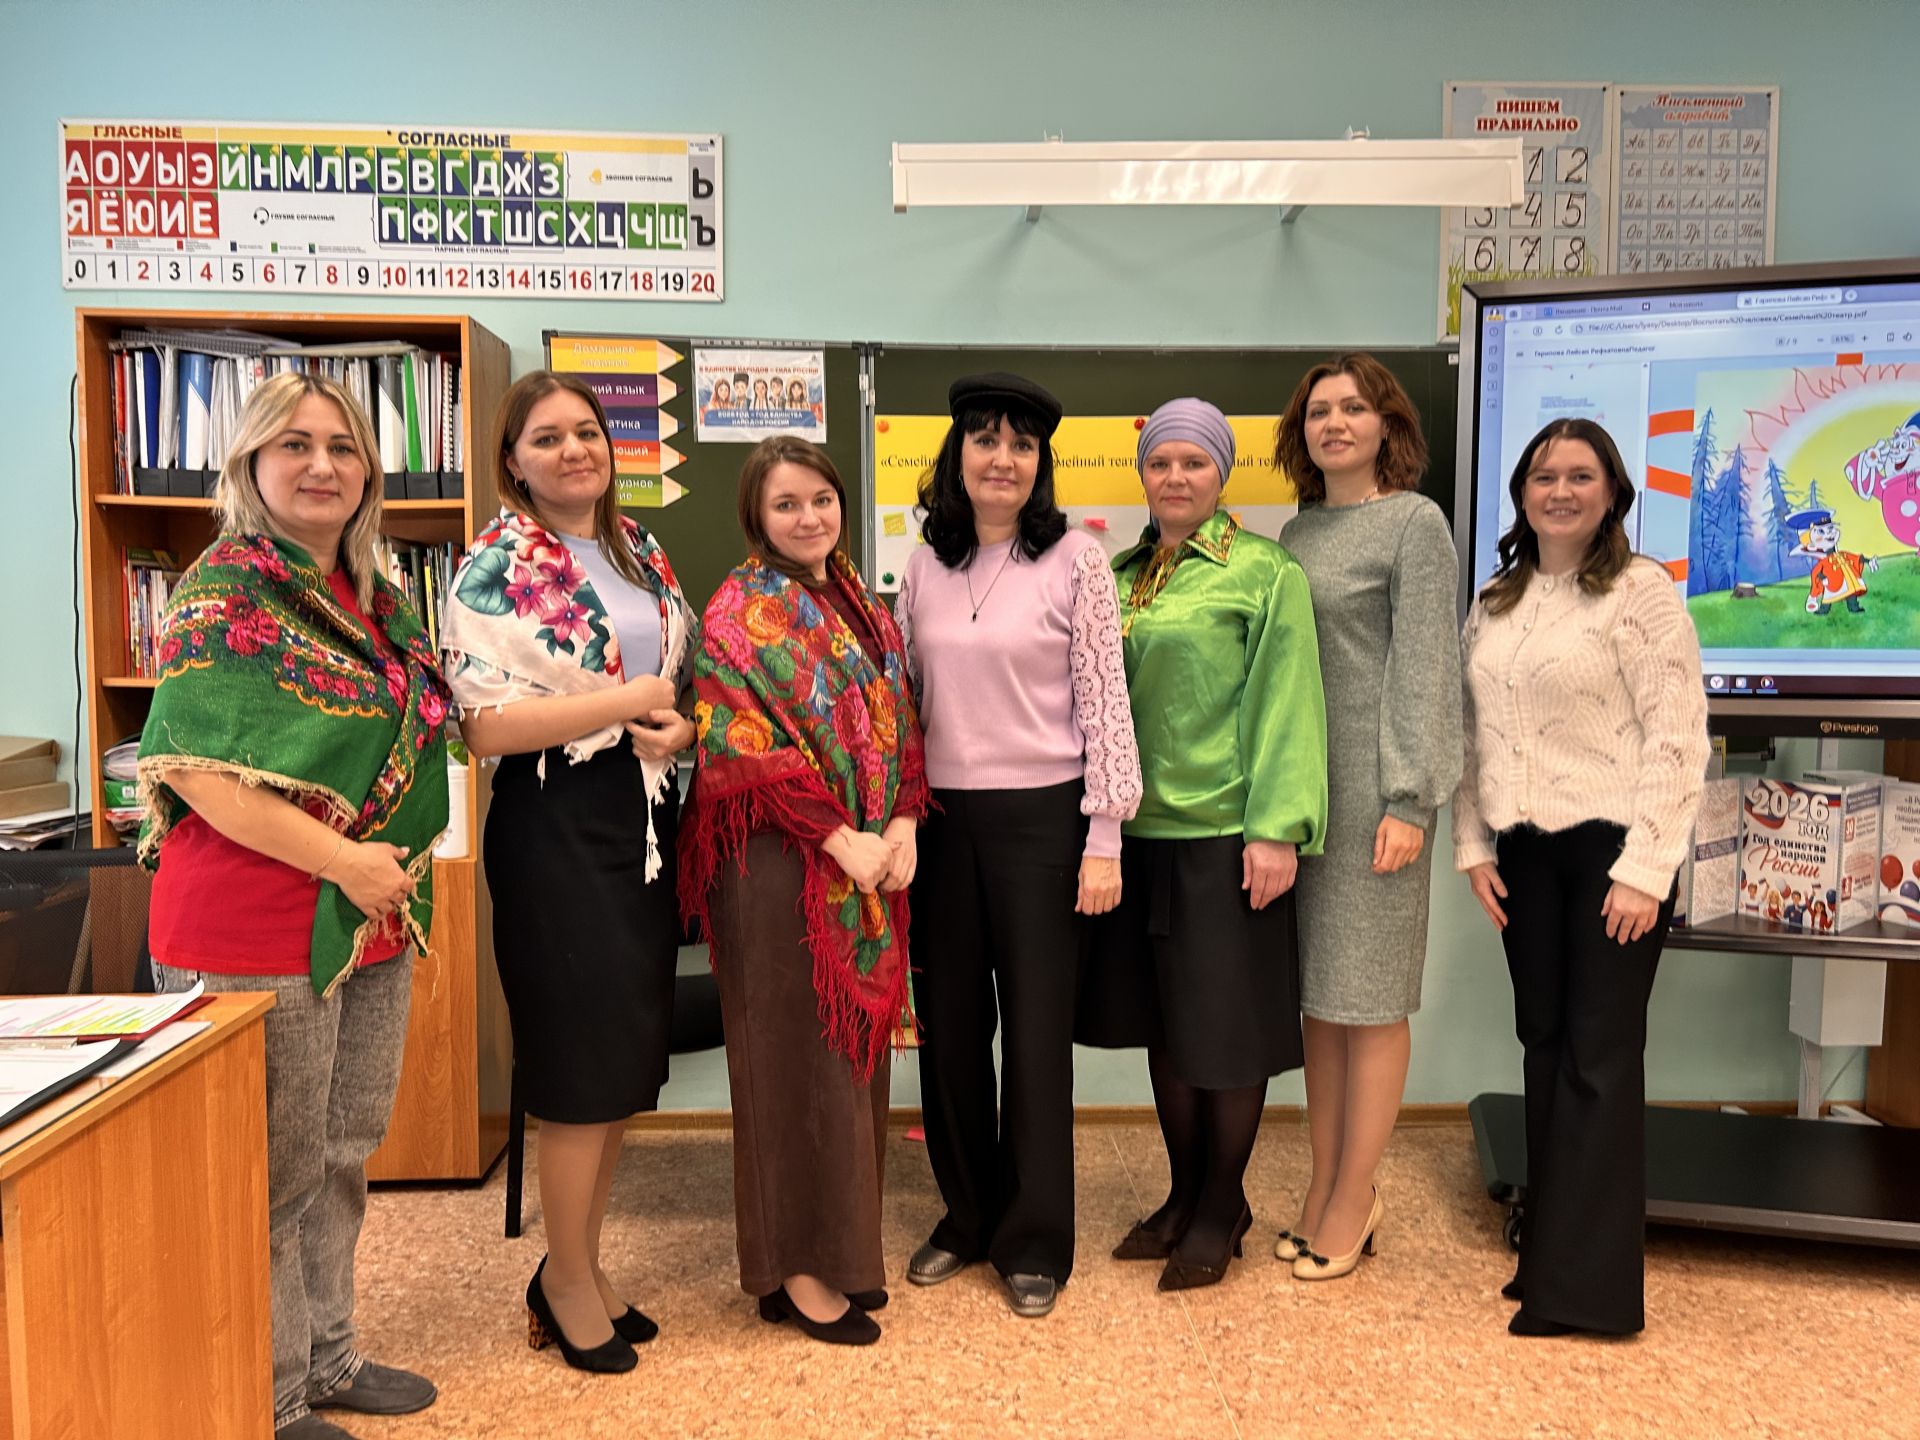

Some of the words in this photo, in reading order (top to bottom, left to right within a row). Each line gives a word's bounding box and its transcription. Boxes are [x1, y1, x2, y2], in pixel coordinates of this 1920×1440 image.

[1496, 99, 1560, 114] ПИШЕМ
[93, 126, 182, 138] ГЛАСНЫЕ
[1477, 117, 1578, 132] ПРАВИЛЬНО
[398, 132, 511, 148] СОГЛАСНЫЕ
[1528, 147, 1543, 182] 1
[1565, 147, 1588, 183] 2
[1525, 192, 1542, 227] 4
[1562, 192, 1586, 228] 5
[1474, 236, 1496, 272] 6
[1520, 236, 1542, 271] 7
[1564, 236, 1584, 272] 8
[75, 260, 86, 279] 0
[108, 261, 117, 279] 1
[137, 262, 150, 280] 2
[168, 262, 181, 281] 3
[200, 263, 213, 282] 4
[232, 263, 244, 282] 5
[263, 264, 276, 283] 6
[294, 265, 306, 283] 7
[326, 265, 338, 284] 8
[358, 266, 370, 285] 9
[382, 267, 406, 287] 10
[416, 268, 437, 287] 11
[445, 269, 469, 288] 12
[476, 269, 500, 289] 13
[506, 270, 530, 289] 14
[538, 270, 562, 290] 15
[569, 271, 592, 290] 16
[600, 272, 622, 290] 17
[630, 272, 653, 291] 18
[661, 273, 684, 292] 19
[691, 273, 715, 292] 20
[591, 384, 612, 395] кий
[616, 385, 645, 395] язык
[606, 419, 640, 430] атика
[614, 446, 648, 457] ющий
[881, 454, 937, 468] «Семейн
[1109, 457, 1137, 469] теат
[616, 479, 653, 489] урное
[1833, 722, 1879, 735] Prestigio
[1752, 786, 1829, 821] 2026
[1753, 833, 1770, 846] Год
[1775, 839, 1826, 853] единства
[1748, 846, 1820, 878] России
[1780, 849, 1826, 864] народов
